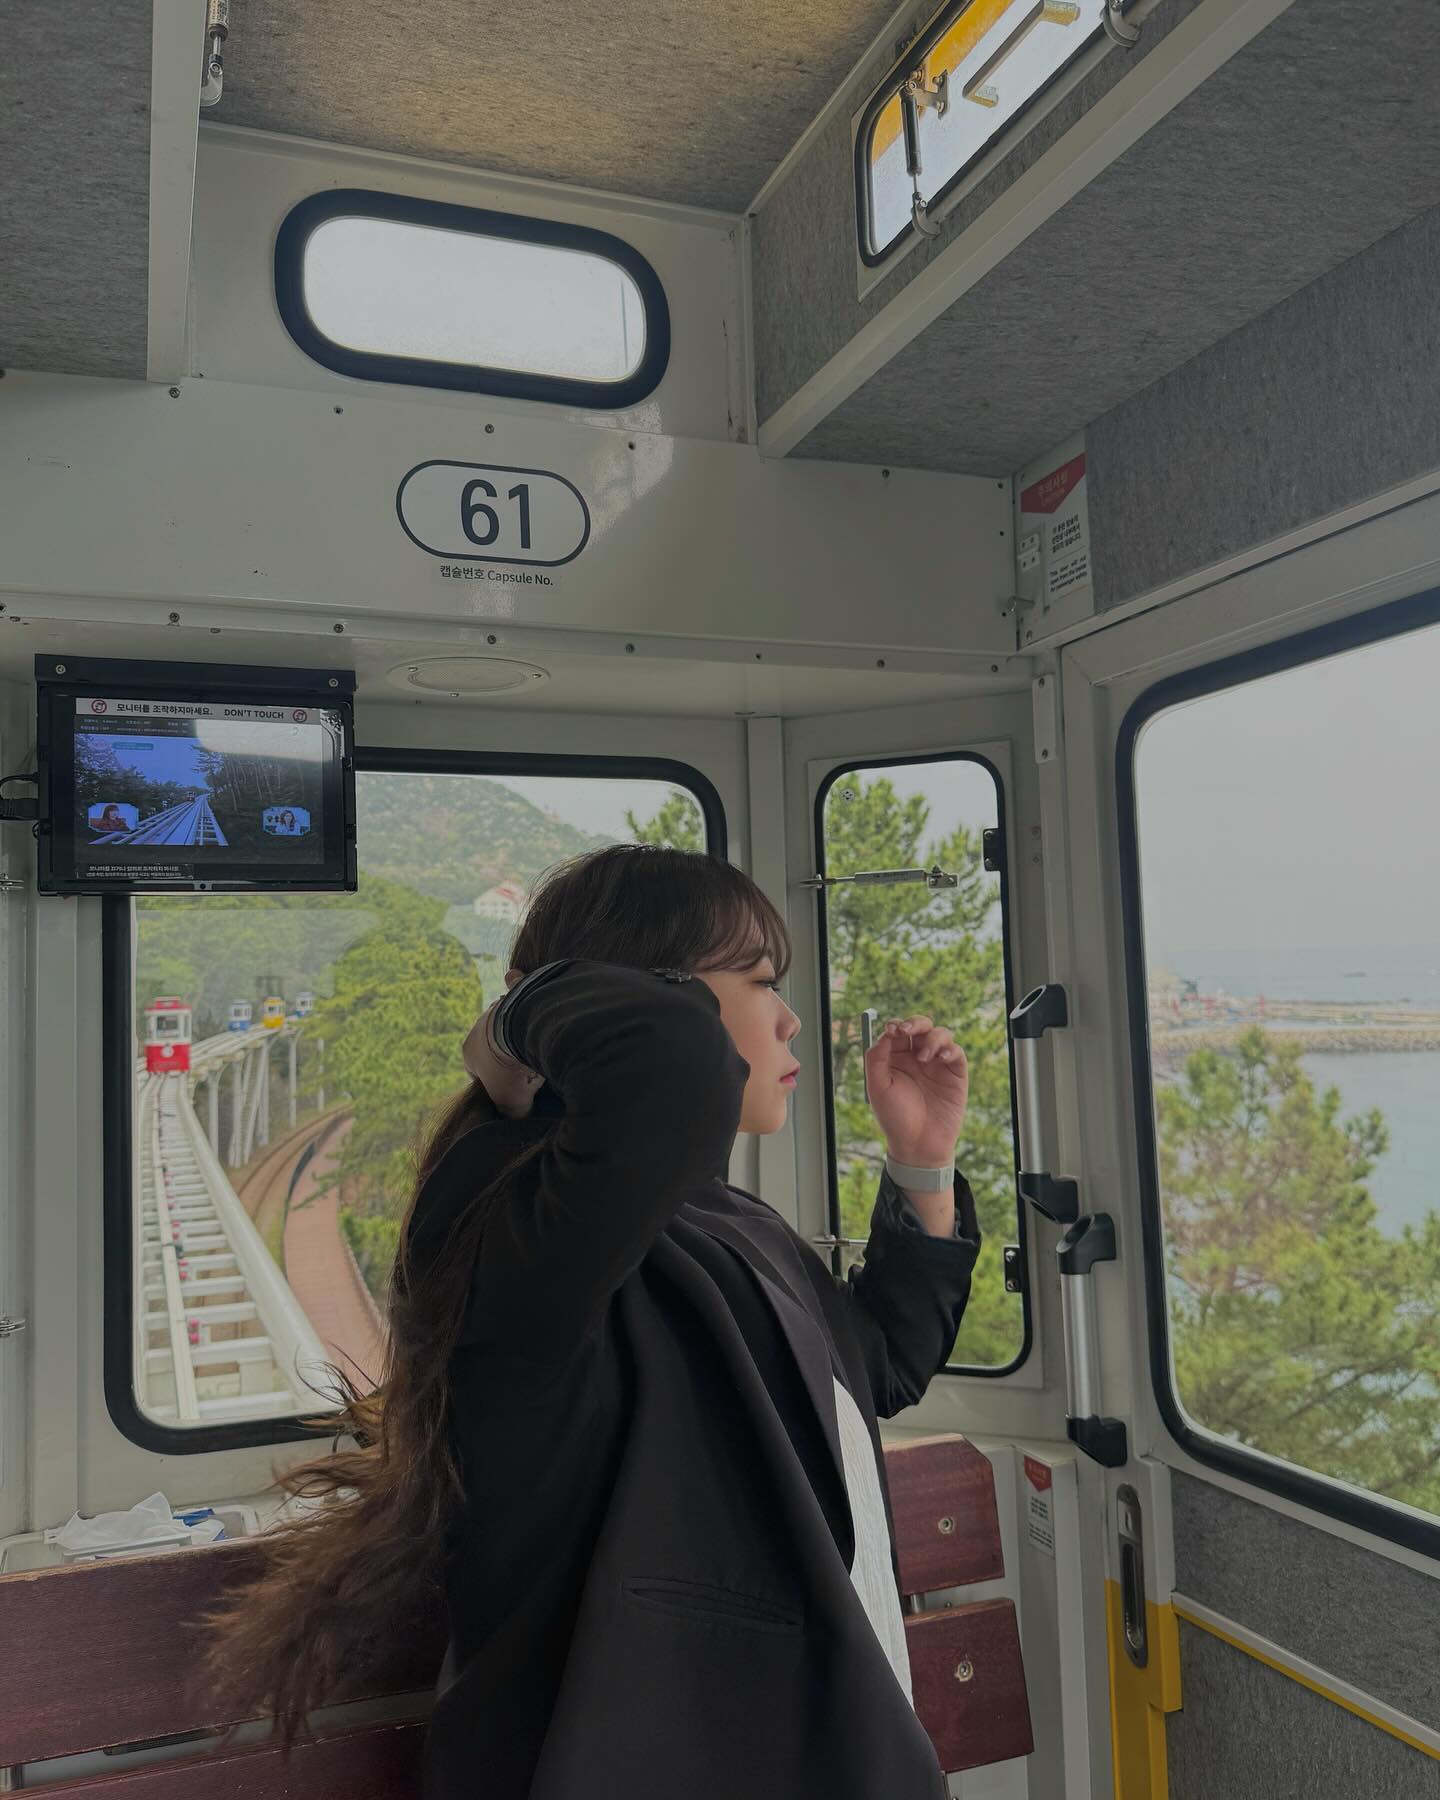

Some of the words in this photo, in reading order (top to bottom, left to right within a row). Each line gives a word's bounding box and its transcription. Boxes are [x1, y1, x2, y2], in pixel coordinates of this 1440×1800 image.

[460, 479, 531, 549] 61
[439, 565, 485, 580] 캡슐번호
[487, 569, 532, 584] Capsule
[535, 575, 553, 586] No.
[116, 703, 150, 713] 모니터를
[224, 708, 251, 717] DON'T
[254, 710, 284, 719] TOUCH
